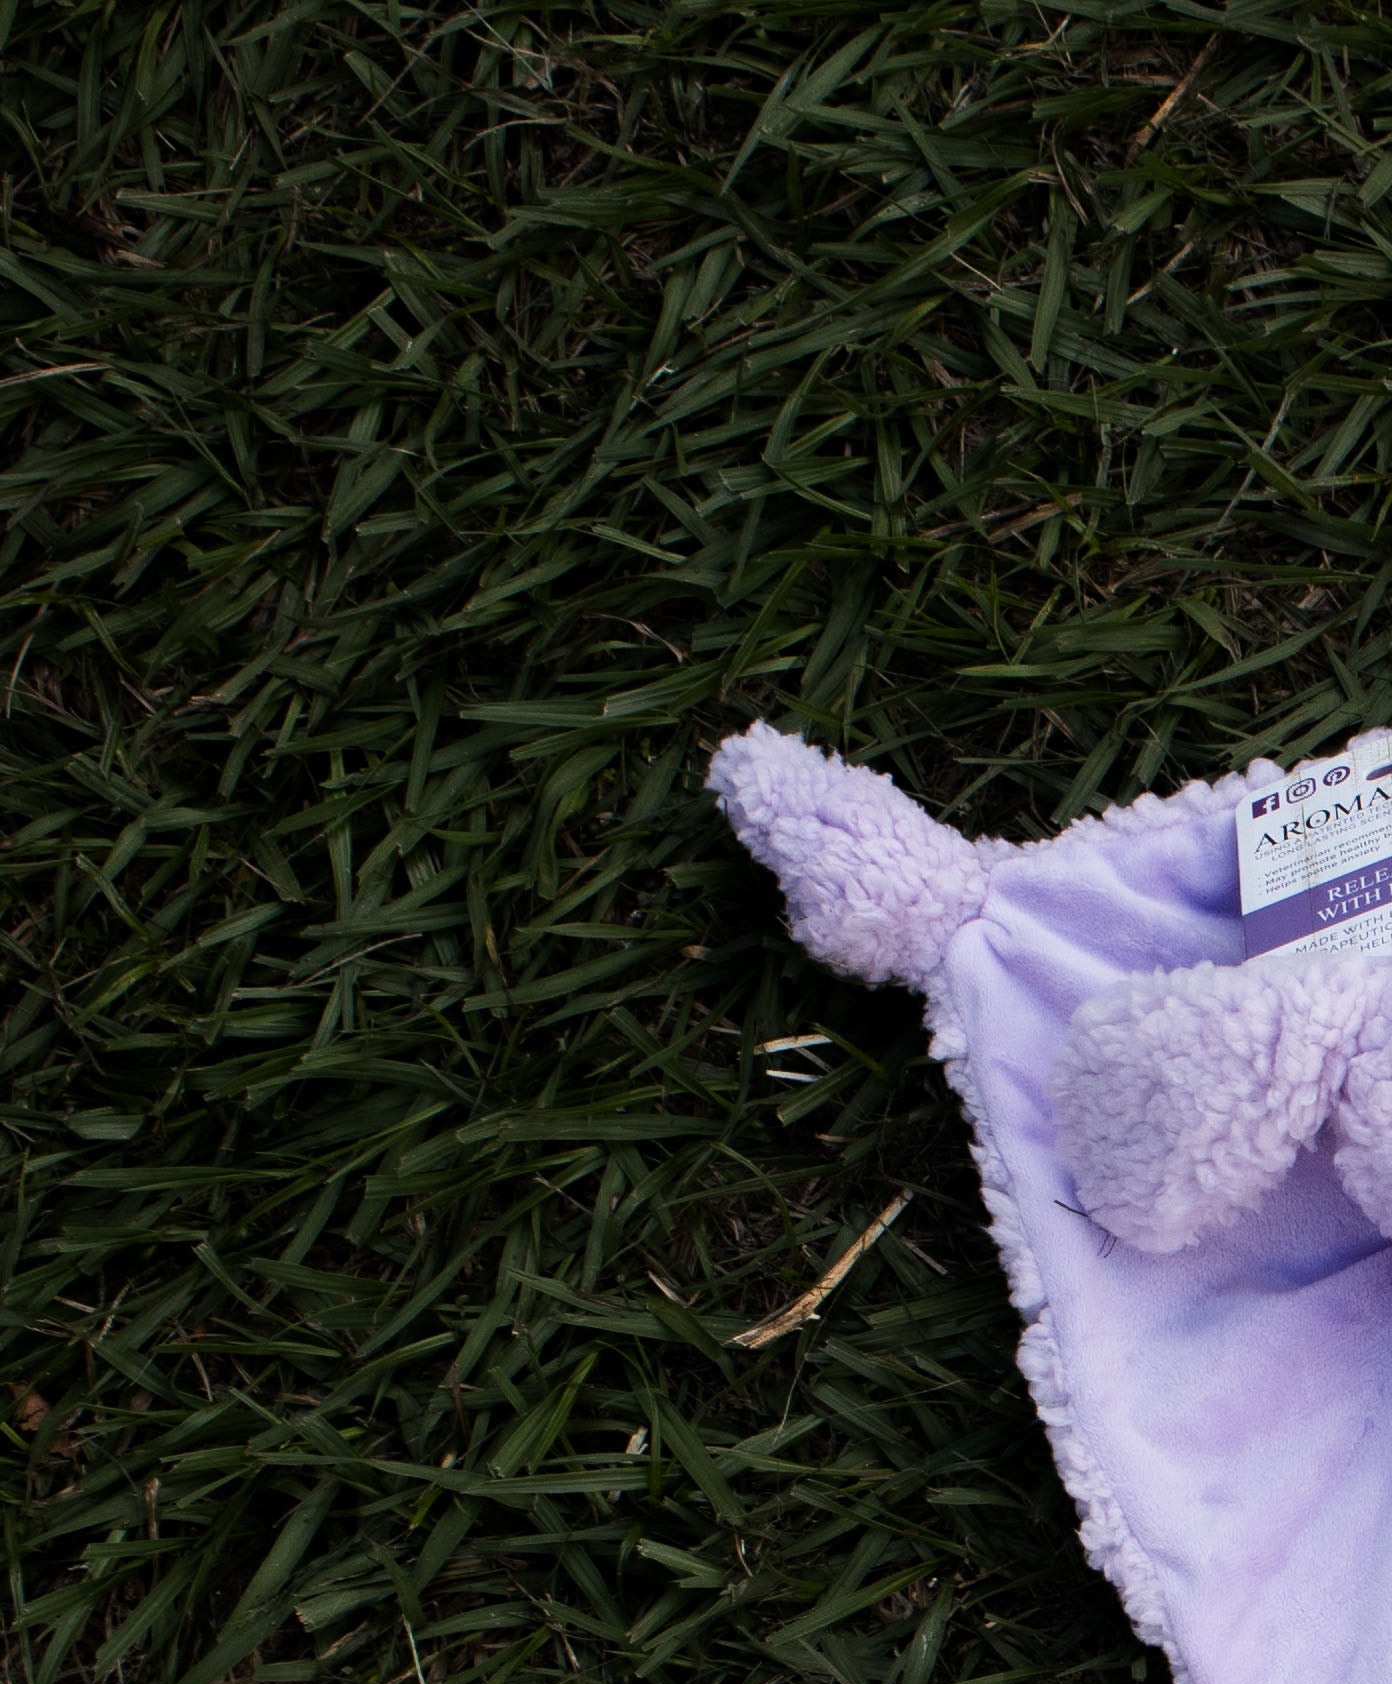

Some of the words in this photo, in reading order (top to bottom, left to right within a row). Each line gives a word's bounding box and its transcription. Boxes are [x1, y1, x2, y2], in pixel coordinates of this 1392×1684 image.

[1266, 872, 1285, 886] May
[1291, 852, 1335, 876] promote
[1340, 835, 1379, 856] healthy
[1272, 843, 1302, 861] LONG
[1308, 823, 1355, 846] LASTING
[1265, 846, 1329, 878] Veterinarian
[1267, 877, 1295, 894] Helps
[1302, 860, 1337, 880] soothe
[1342, 844, 1379, 864] anxiety
[1317, 887, 1380, 921] WITH
[1295, 931, 1336, 953] MADE
[1342, 914, 1383, 934] WITH
